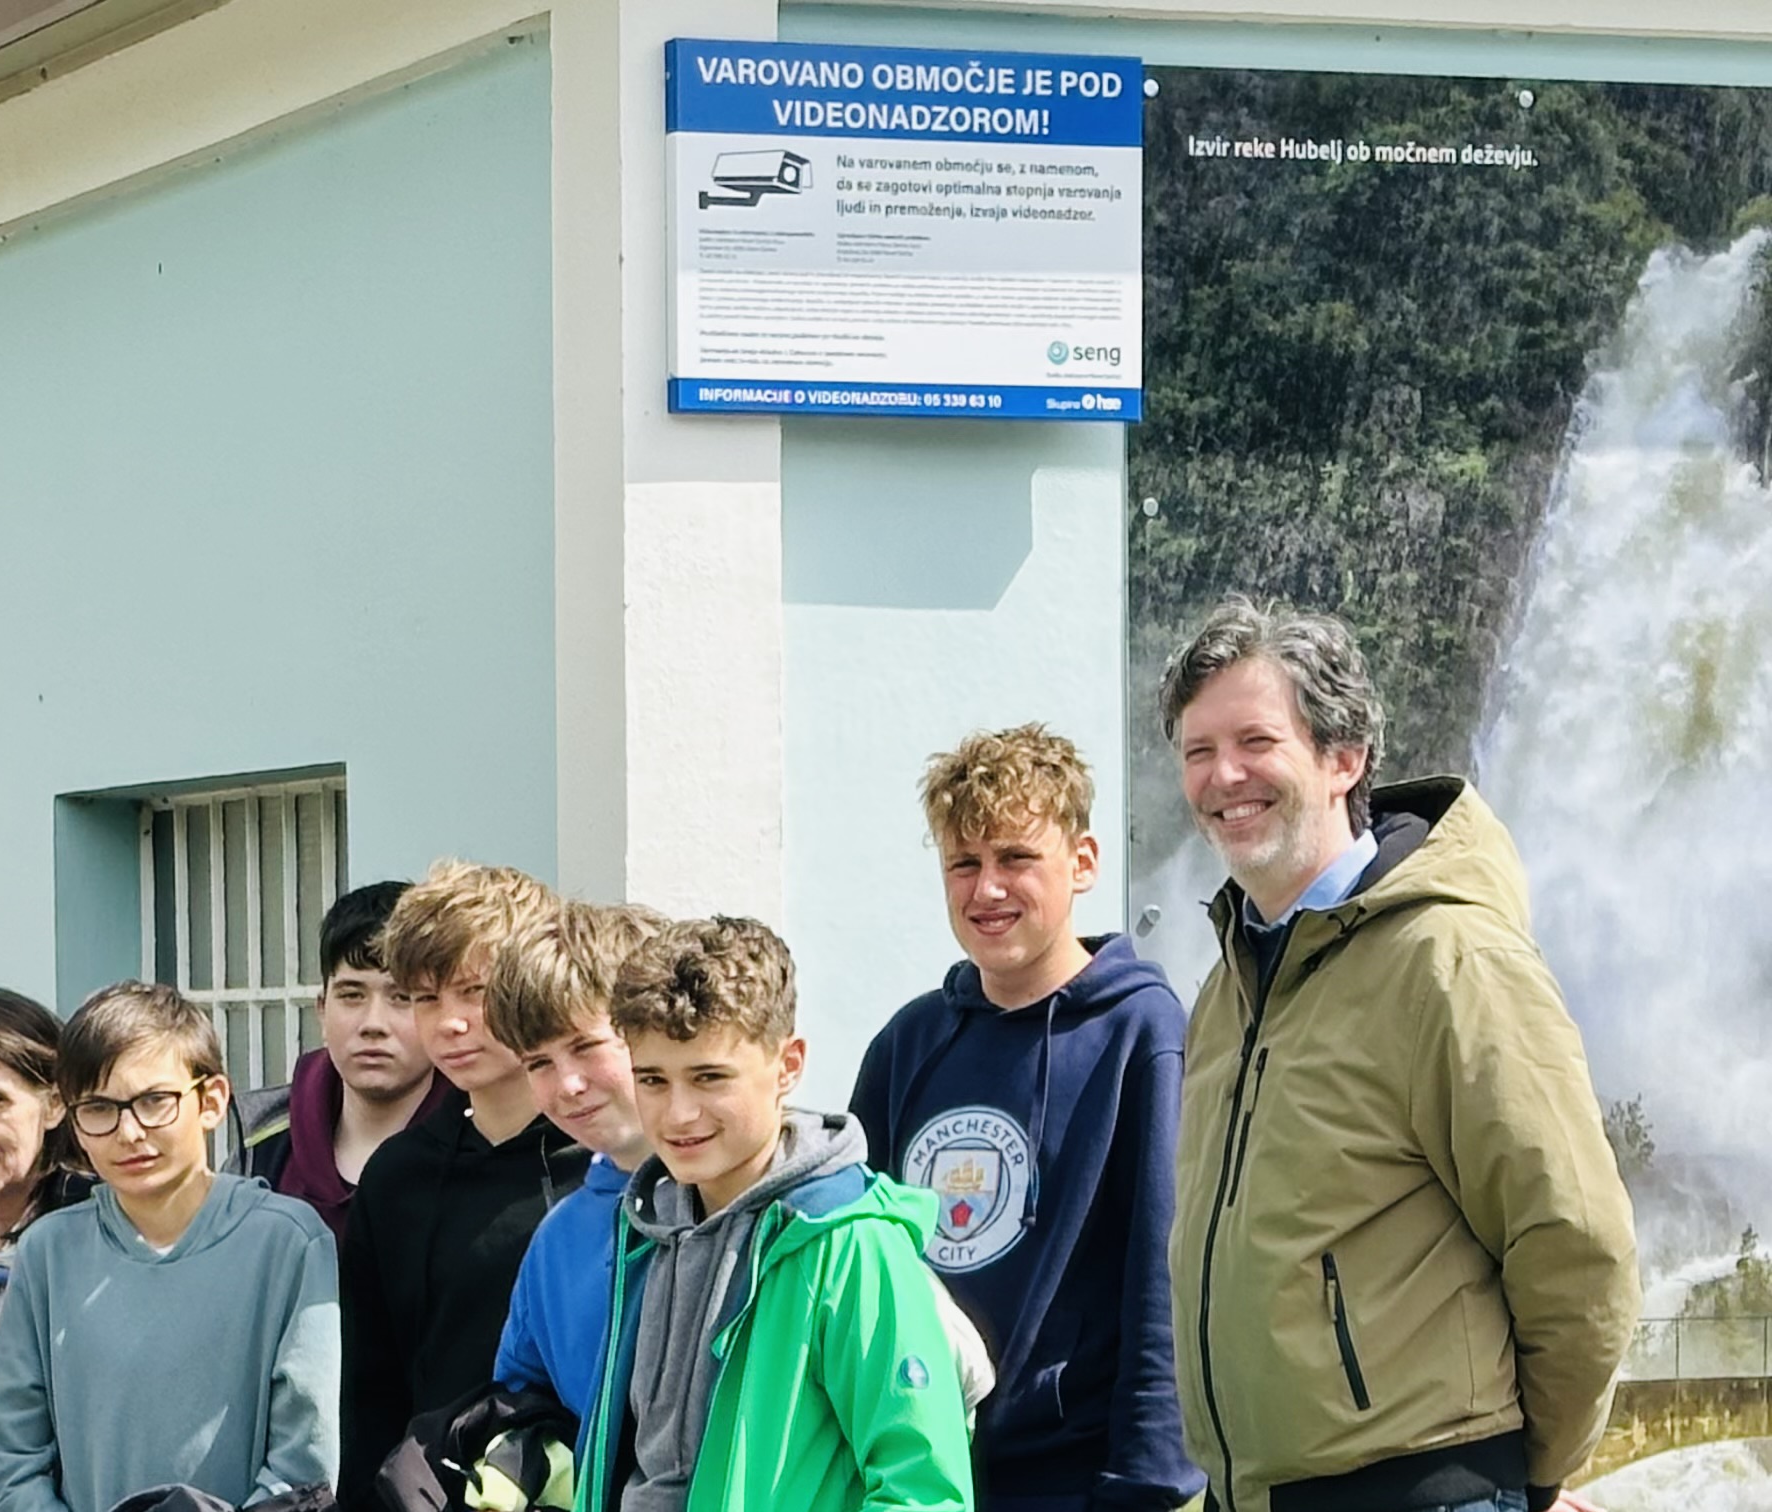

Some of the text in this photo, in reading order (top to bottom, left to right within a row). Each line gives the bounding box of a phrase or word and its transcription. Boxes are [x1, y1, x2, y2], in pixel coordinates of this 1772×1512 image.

[696, 57, 1122, 98] VAROVANO OBMOČJE JE POD
[773, 99, 1050, 136] VIDEONADZOROM!
[1188, 135, 1539, 171] Izvir reke Hubelj ob močnem deževju.
[836, 154, 1099, 178] Na varovanem območju se, z namenom,
[836, 177, 1123, 201] da se zagotovi optimalna stopnja varovanja
[836, 200, 866, 216] ljudi
[869, 202, 882, 215] in
[970, 204, 1008, 222] izvaja
[1011, 206, 1096, 222] videonadzor.
[1073, 346, 1122, 366] seng
[699, 388, 791, 404] INFORMACIJE
[794, 389, 805, 404] O
[988, 395, 1002, 408] 10
[912, 1118, 1025, 1168] MANCHESTER
[938, 1244, 978, 1262] CITY
